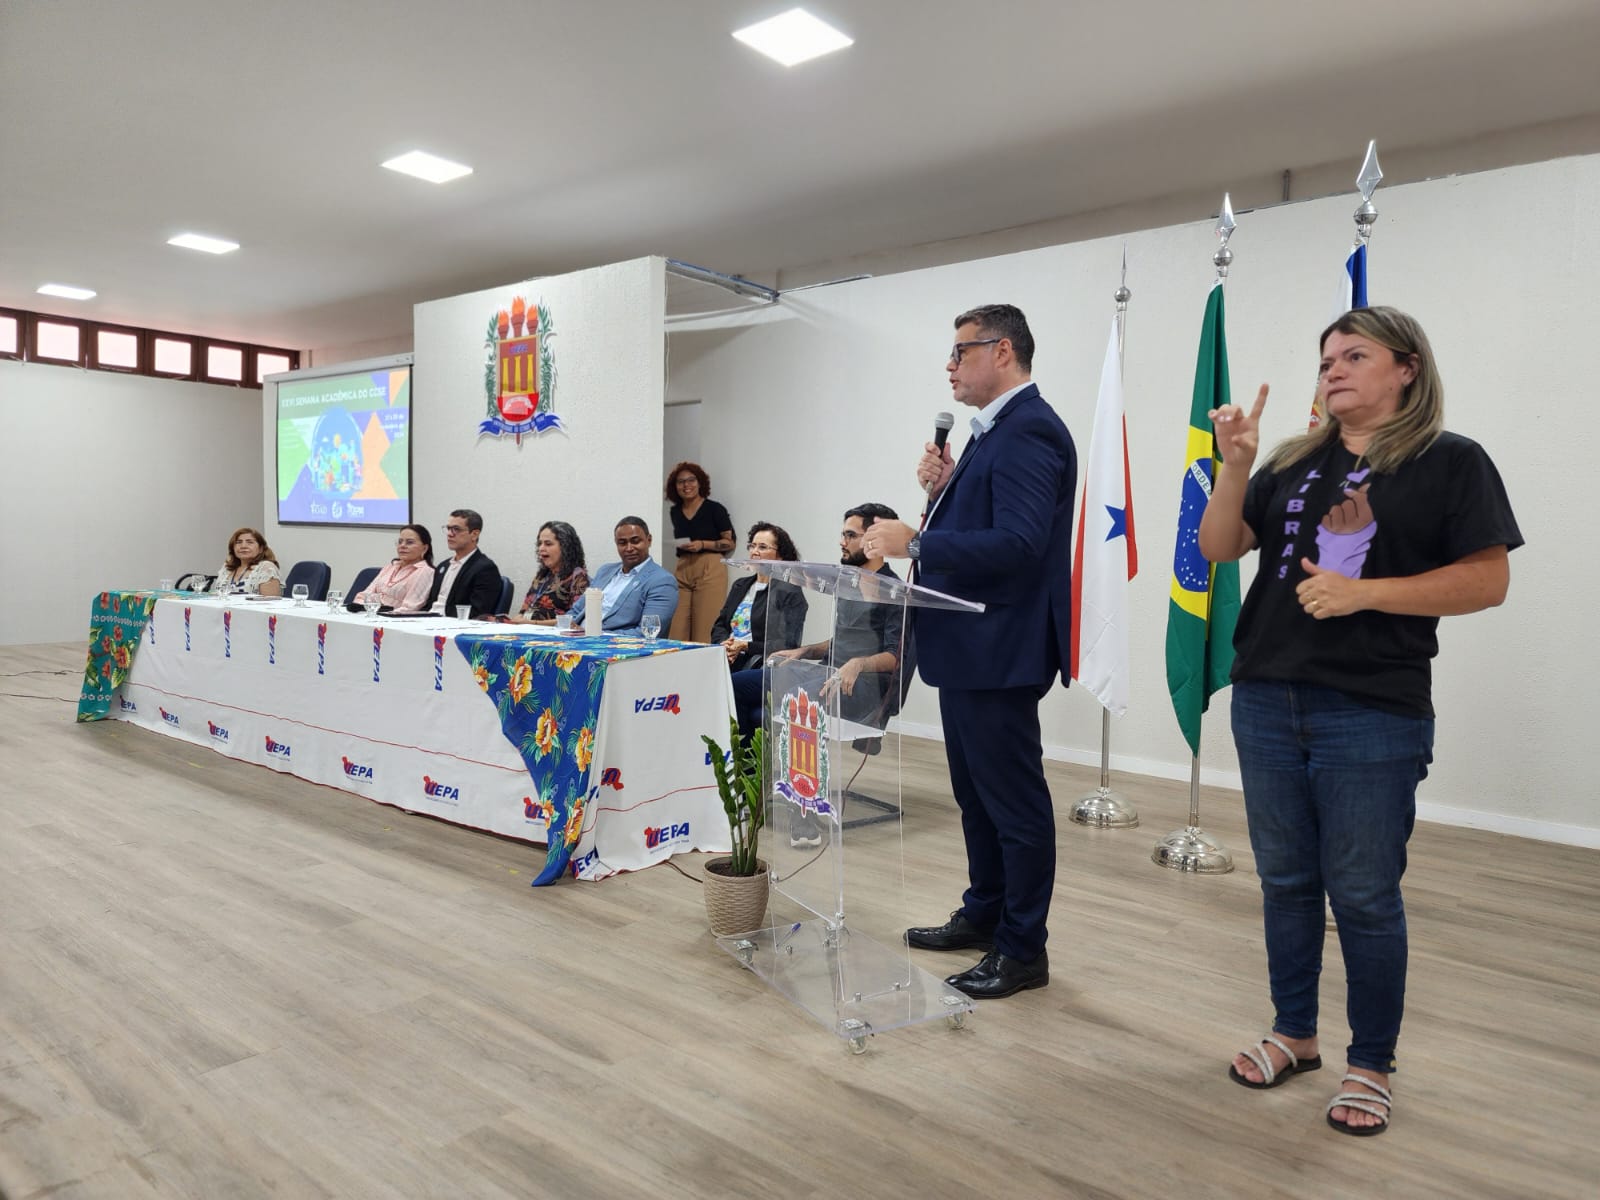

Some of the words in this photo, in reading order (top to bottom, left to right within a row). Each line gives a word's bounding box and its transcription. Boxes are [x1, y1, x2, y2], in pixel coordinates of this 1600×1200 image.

[1278, 470, 1322, 579] LIBRAS
[318, 623, 327, 675] UEPA
[373, 627, 385, 683] UEPA
[434, 635, 447, 692] UEPA
[635, 694, 680, 715] UEPA
[265, 738, 291, 757] UEPA
[343, 759, 373, 779] UEPA
[425, 779, 459, 801] UEPA
[645, 822, 690, 848] UEPA
